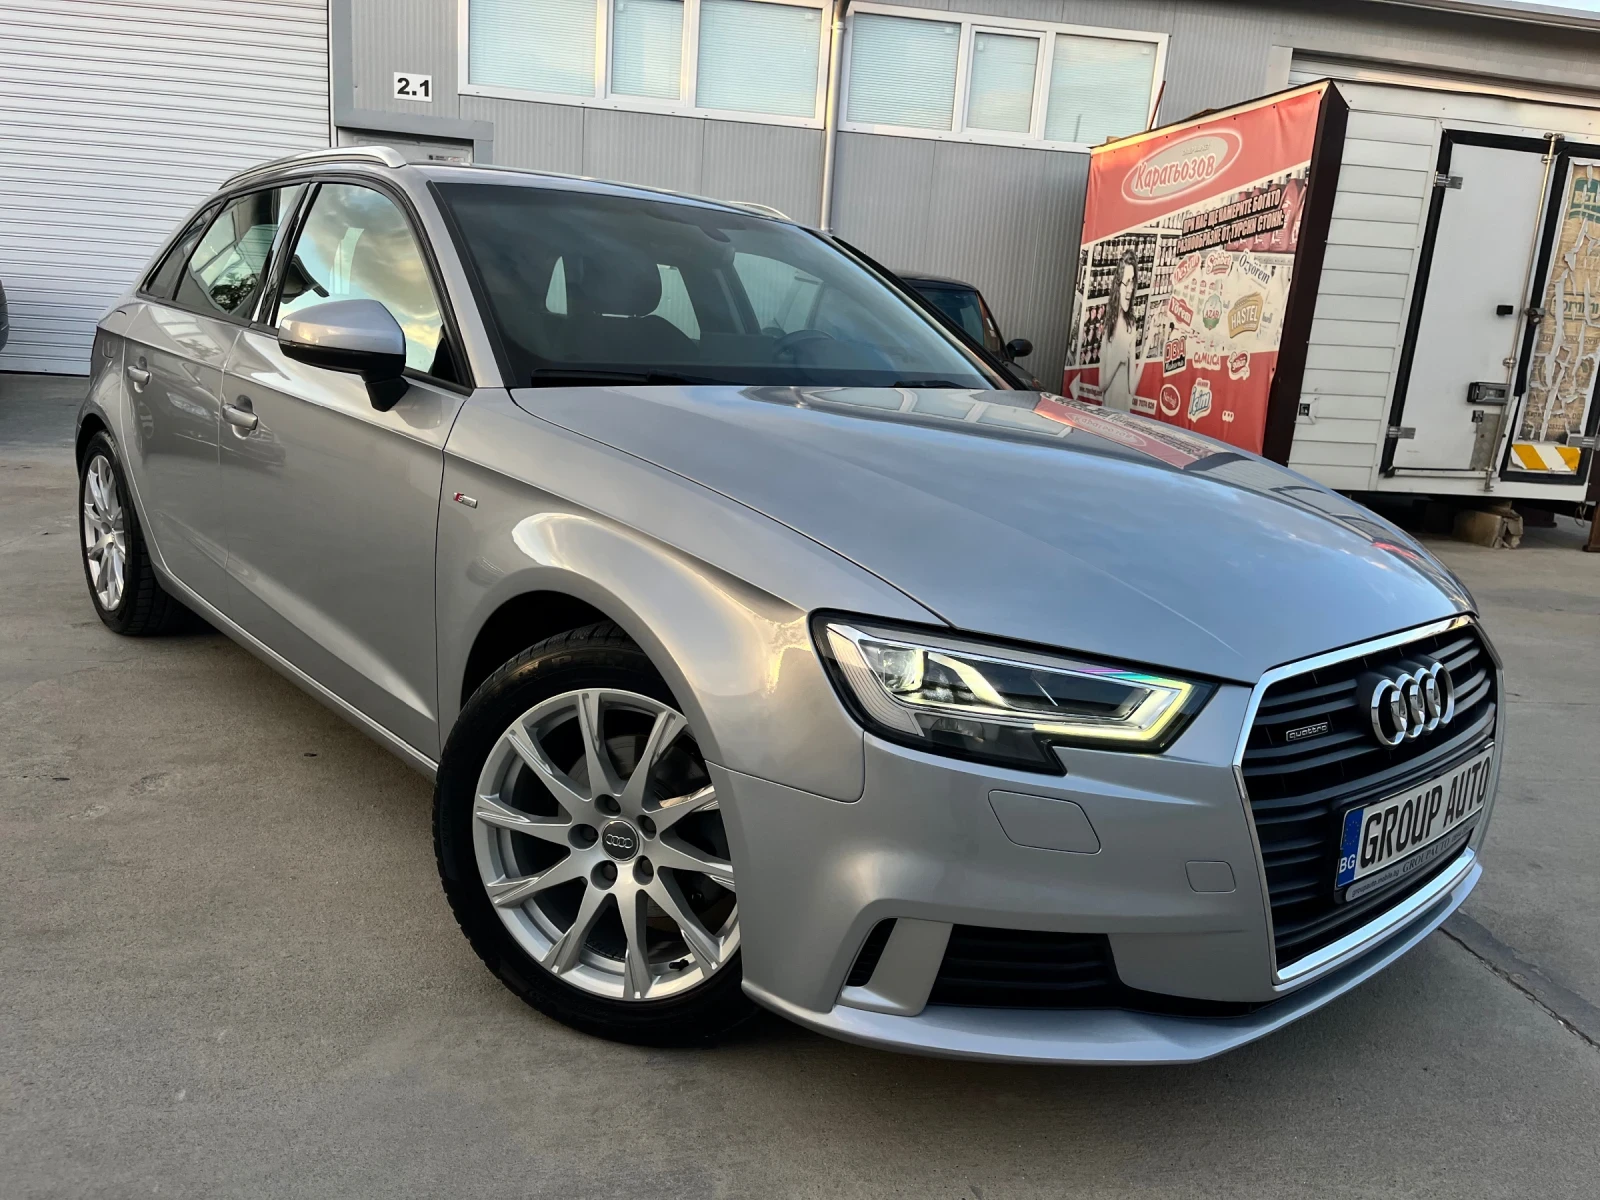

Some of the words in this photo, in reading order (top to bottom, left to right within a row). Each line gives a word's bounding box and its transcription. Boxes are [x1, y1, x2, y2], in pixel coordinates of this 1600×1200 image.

[397, 77, 429, 97] 2.1
[1134, 154, 1216, 196] Карагьозов
[1252, 189, 1281, 212] БОГАТО
[1221, 225, 1230, 242] ОТ
[1231, 218, 1257, 240] ТУРСКИ
[1239, 250, 1271, 284] Özyörem
[1231, 305, 1258, 329] HASTEL
[1289, 724, 1328, 739] quattro
[1360, 785, 1442, 869] GROUP
[1443, 756, 1491, 828] AUTO
[1339, 854, 1356, 874] BG
[1402, 838, 1450, 873] GROUPAUTO
